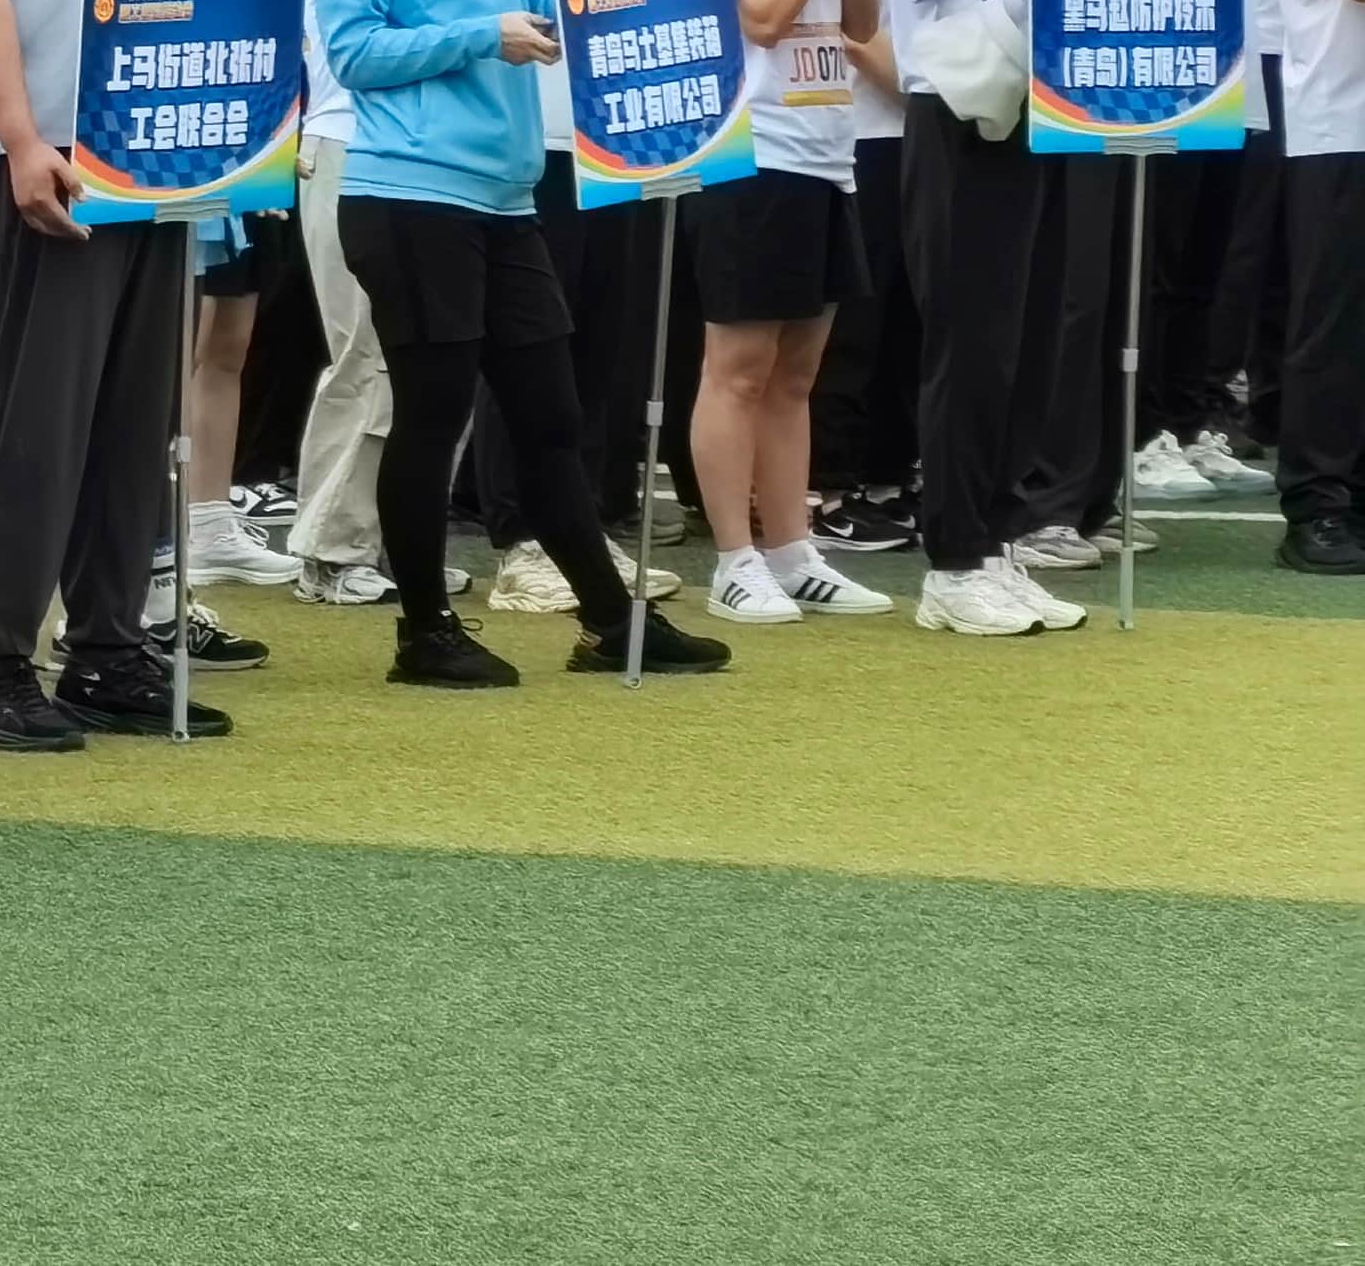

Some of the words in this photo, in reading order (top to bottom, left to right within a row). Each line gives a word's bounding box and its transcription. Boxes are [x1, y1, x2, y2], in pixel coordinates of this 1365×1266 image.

[106, 37, 277, 92] 上马街道北张村
[128, 100, 249, 150] 工会联合会
[604, 74, 722, 135] 工业有限公司
